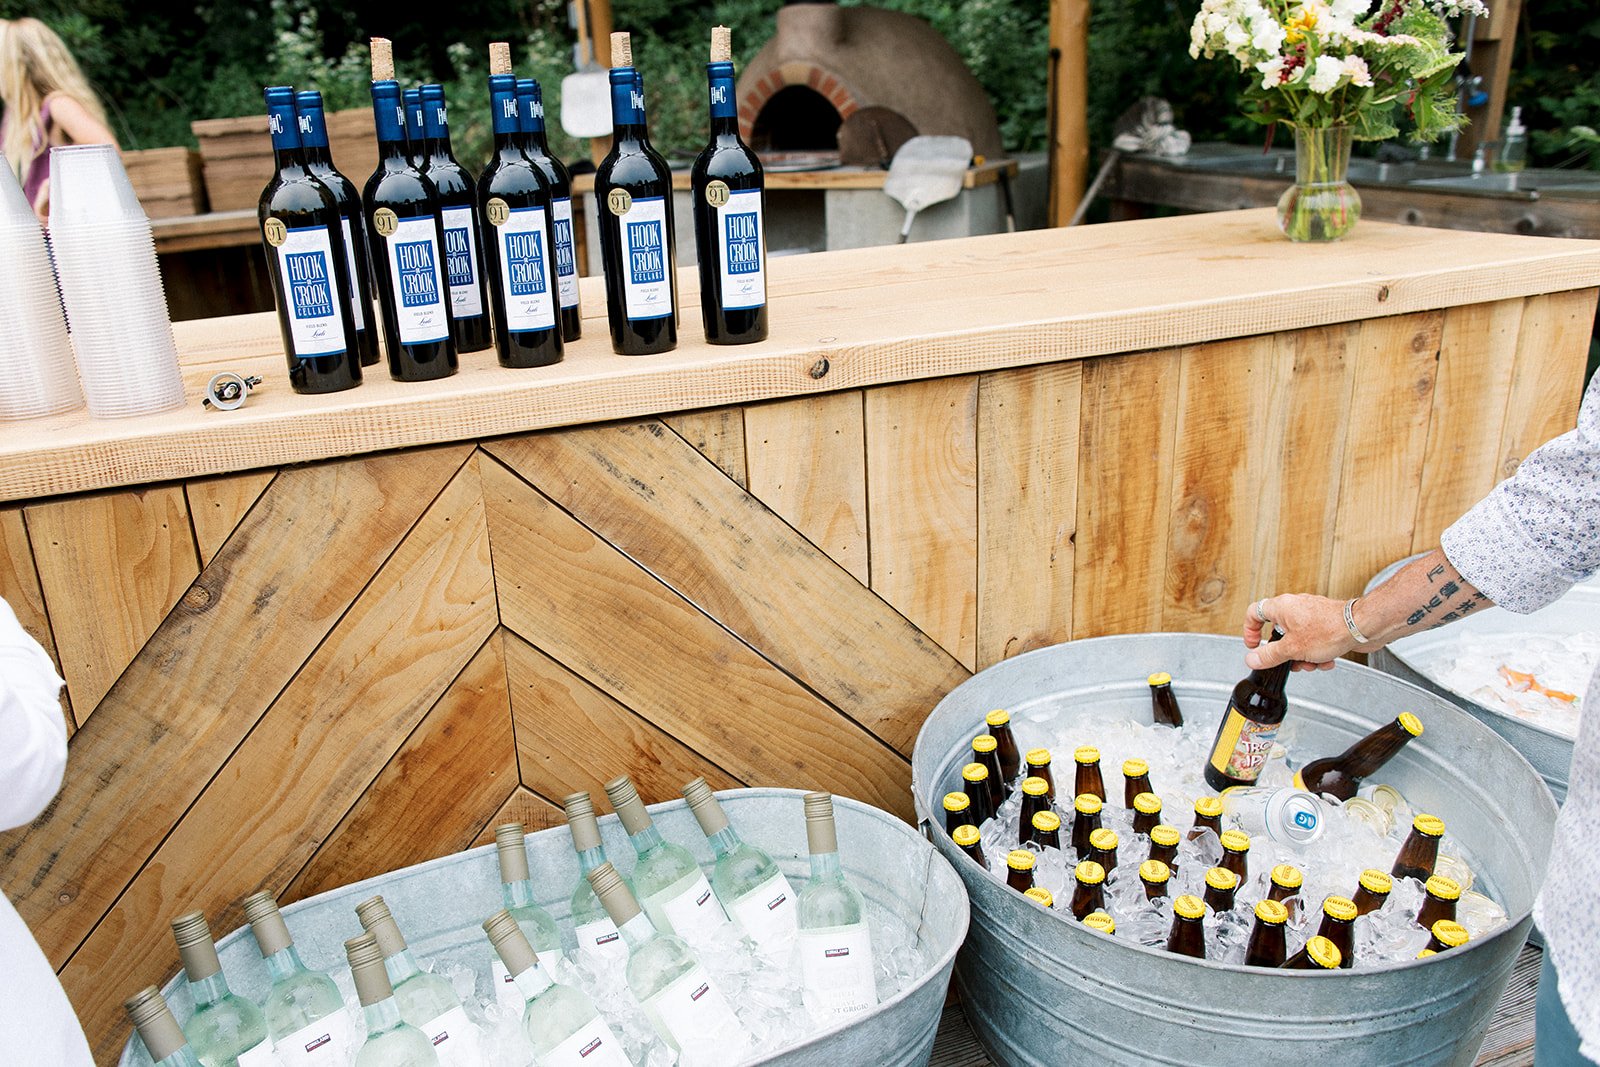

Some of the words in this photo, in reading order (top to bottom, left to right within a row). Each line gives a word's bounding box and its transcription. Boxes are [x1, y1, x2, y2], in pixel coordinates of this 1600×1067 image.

[611, 196, 627, 210] 91
[709, 188, 725, 203] 91
[489, 206, 504, 220] 91
[377, 216, 393, 231] 91
[554, 221, 570, 244] OOK
[728, 215, 757, 239] HOOK
[267, 226, 283, 242] 91
[445, 230, 468, 253] OOK
[630, 223, 660, 248] HOOK
[399, 243, 432, 269] HOOK
[508, 233, 540, 259] HOOK
[729, 242, 757, 262] CROOK
[289, 254, 325, 281] HOOK
[447, 255, 470, 275] ROOK
[632, 250, 662, 272] CROOK
[730, 262, 758, 272] CELLARS
[511, 261, 543, 284] CROOK
[634, 271, 662, 282] CELLARS
[402, 272, 435, 294] CROOK
[513, 282, 544, 293] CELLARS
[293, 283, 328, 306] CROOK
[405, 293, 437, 304] CELLARS
[297, 305, 331, 317] CELLARS
[843, 1003, 869, 1013] GRIGIO
